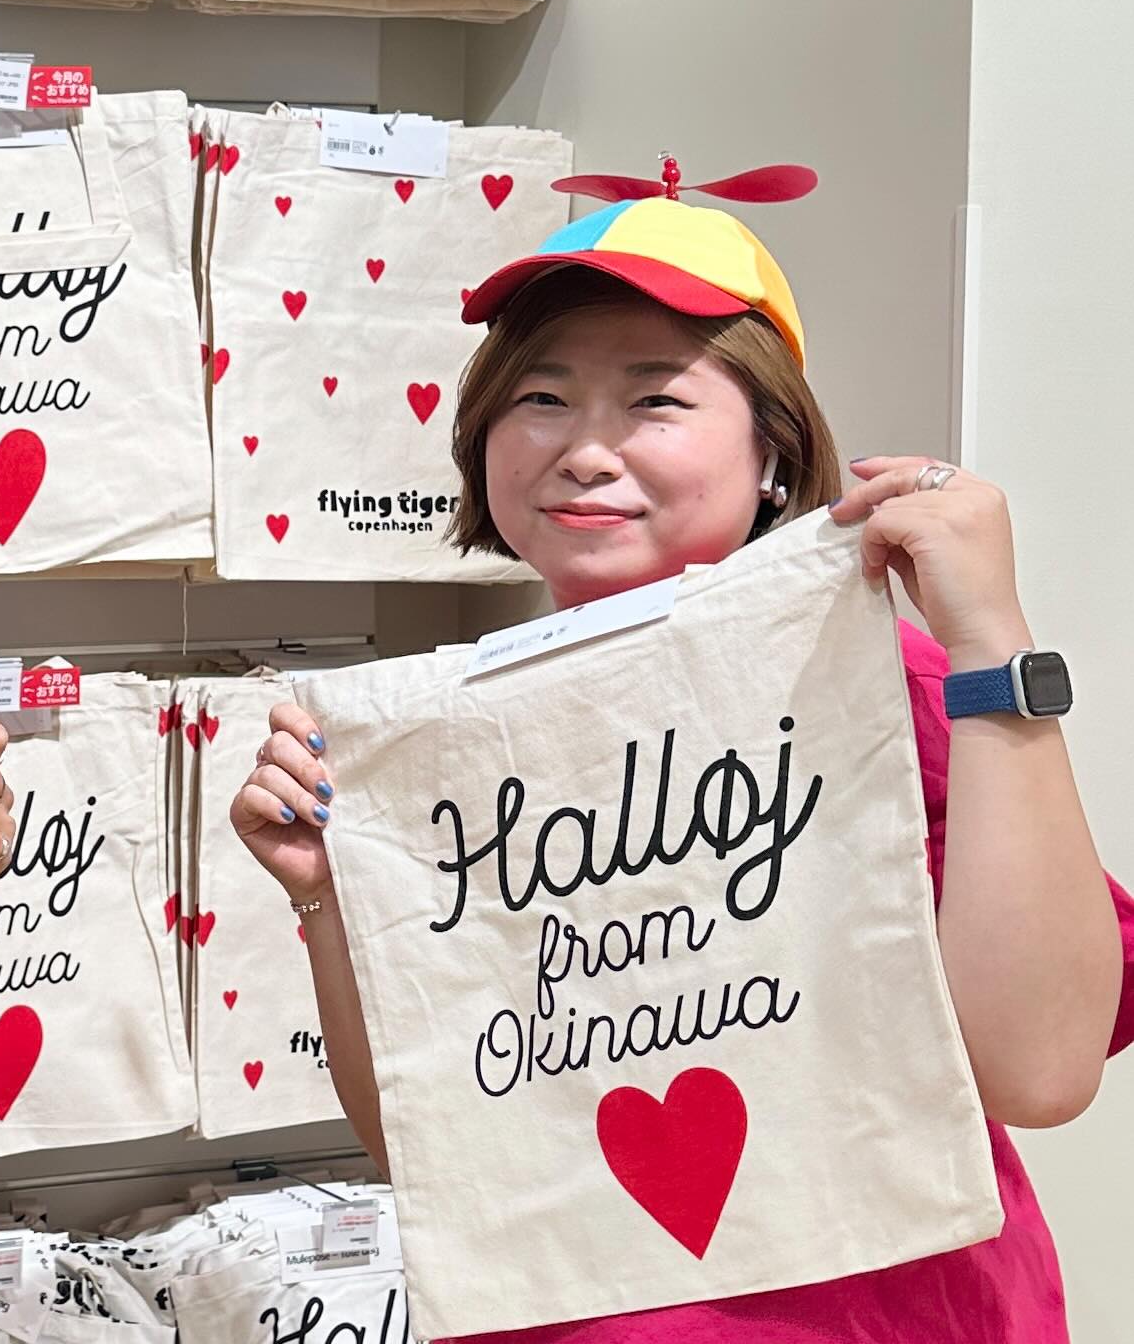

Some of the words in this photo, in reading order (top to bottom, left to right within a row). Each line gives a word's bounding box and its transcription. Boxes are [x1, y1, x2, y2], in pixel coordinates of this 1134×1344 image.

[52, 71, 84, 84] 今月の
[46, 83, 89, 96] おすすめ
[317, 489, 392, 518] flying
[397, 490, 461, 519] tiger
[348, 519, 433, 534] copenhagen
[42, 673, 73, 686] 今月の
[36, 684, 78, 698] おすすめ
[430, 716, 823, 933] Halløj
[538, 905, 715, 1020] from
[290, 1030, 324, 1057] fly
[476, 976, 800, 1097] Okinawa
